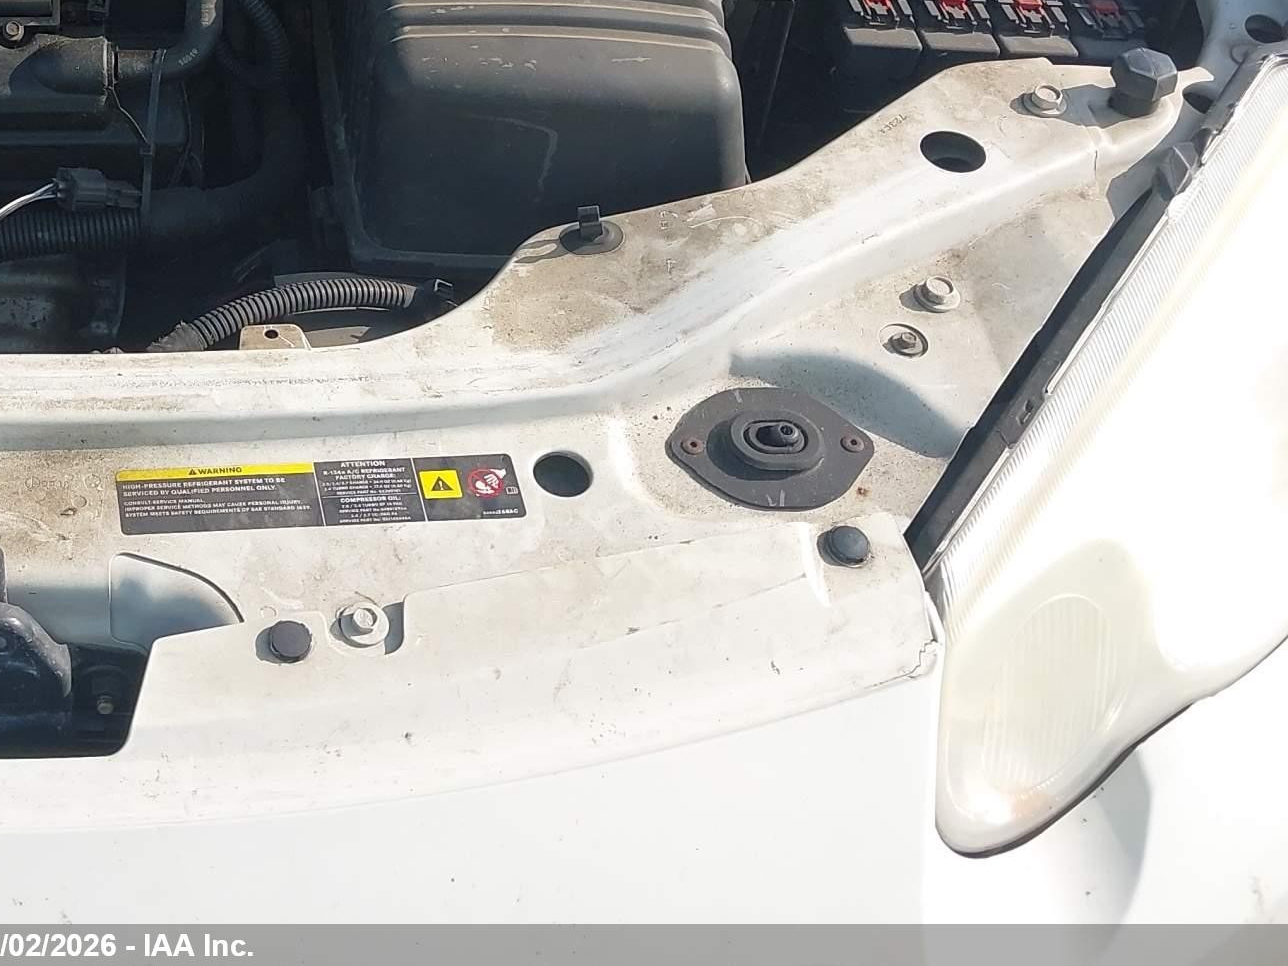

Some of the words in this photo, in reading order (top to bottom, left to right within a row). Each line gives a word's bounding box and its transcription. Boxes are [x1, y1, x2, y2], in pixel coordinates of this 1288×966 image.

[198, 467, 242, 475] WARNING
[122, 482, 182, 490] HIGH-PRESSURE
[184, 480, 232, 488] REFRIGERANT
